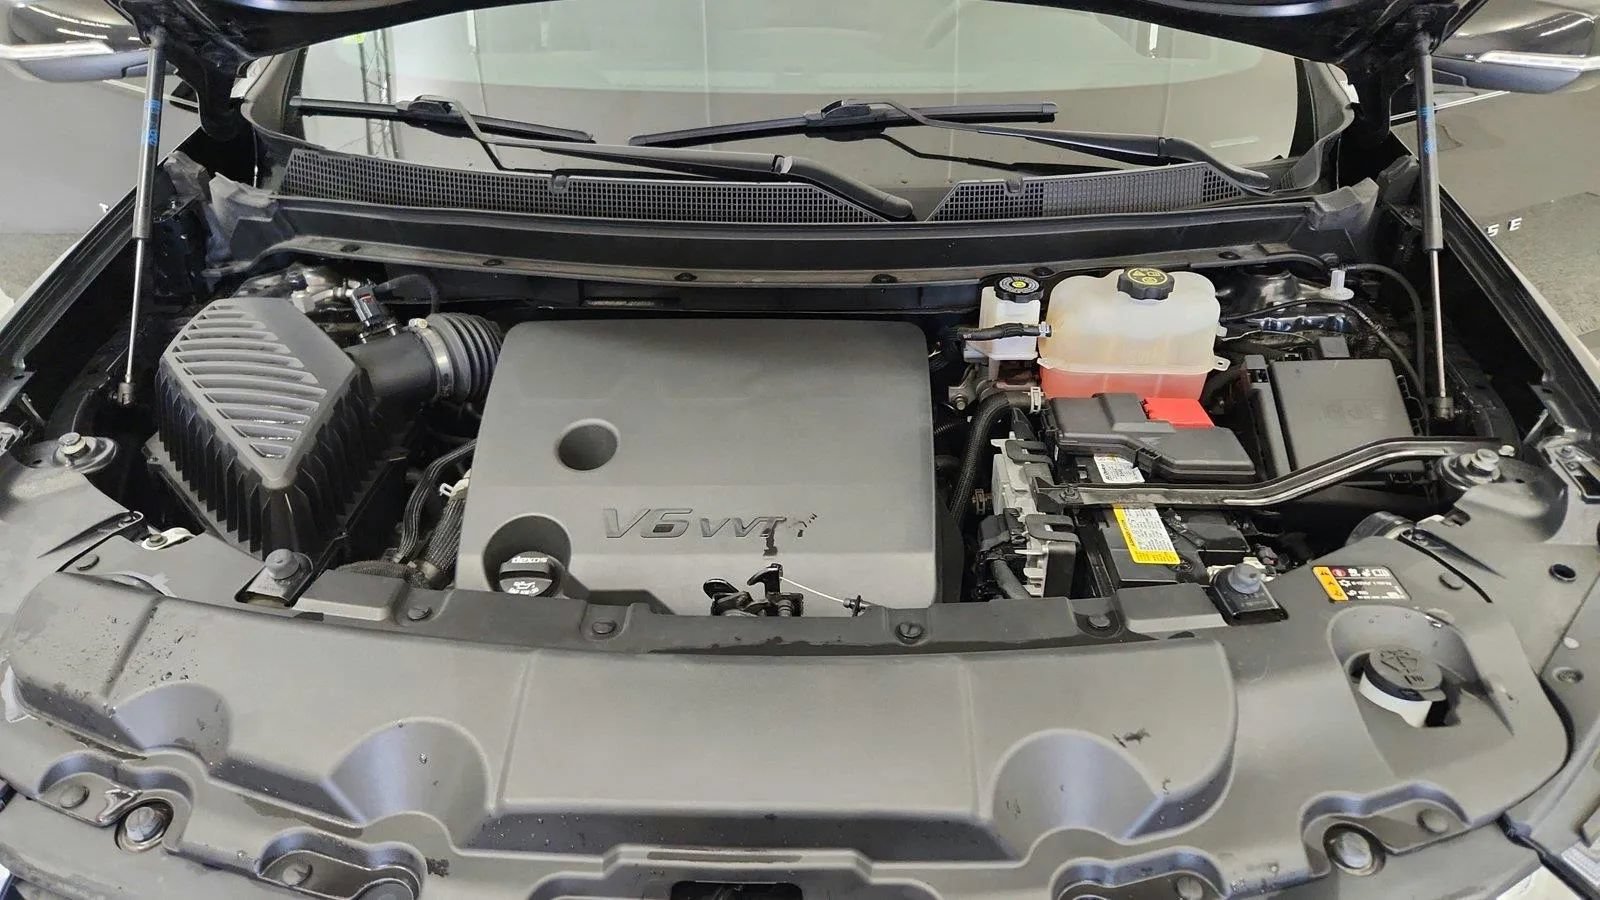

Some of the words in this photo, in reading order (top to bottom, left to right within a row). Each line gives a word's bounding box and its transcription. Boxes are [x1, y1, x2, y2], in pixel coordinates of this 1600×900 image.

[1486, 217, 1523, 237] SE
[602, 508, 693, 538] V6
[699, 516, 787, 538] VVT
[511, 555, 549, 564] dexos
